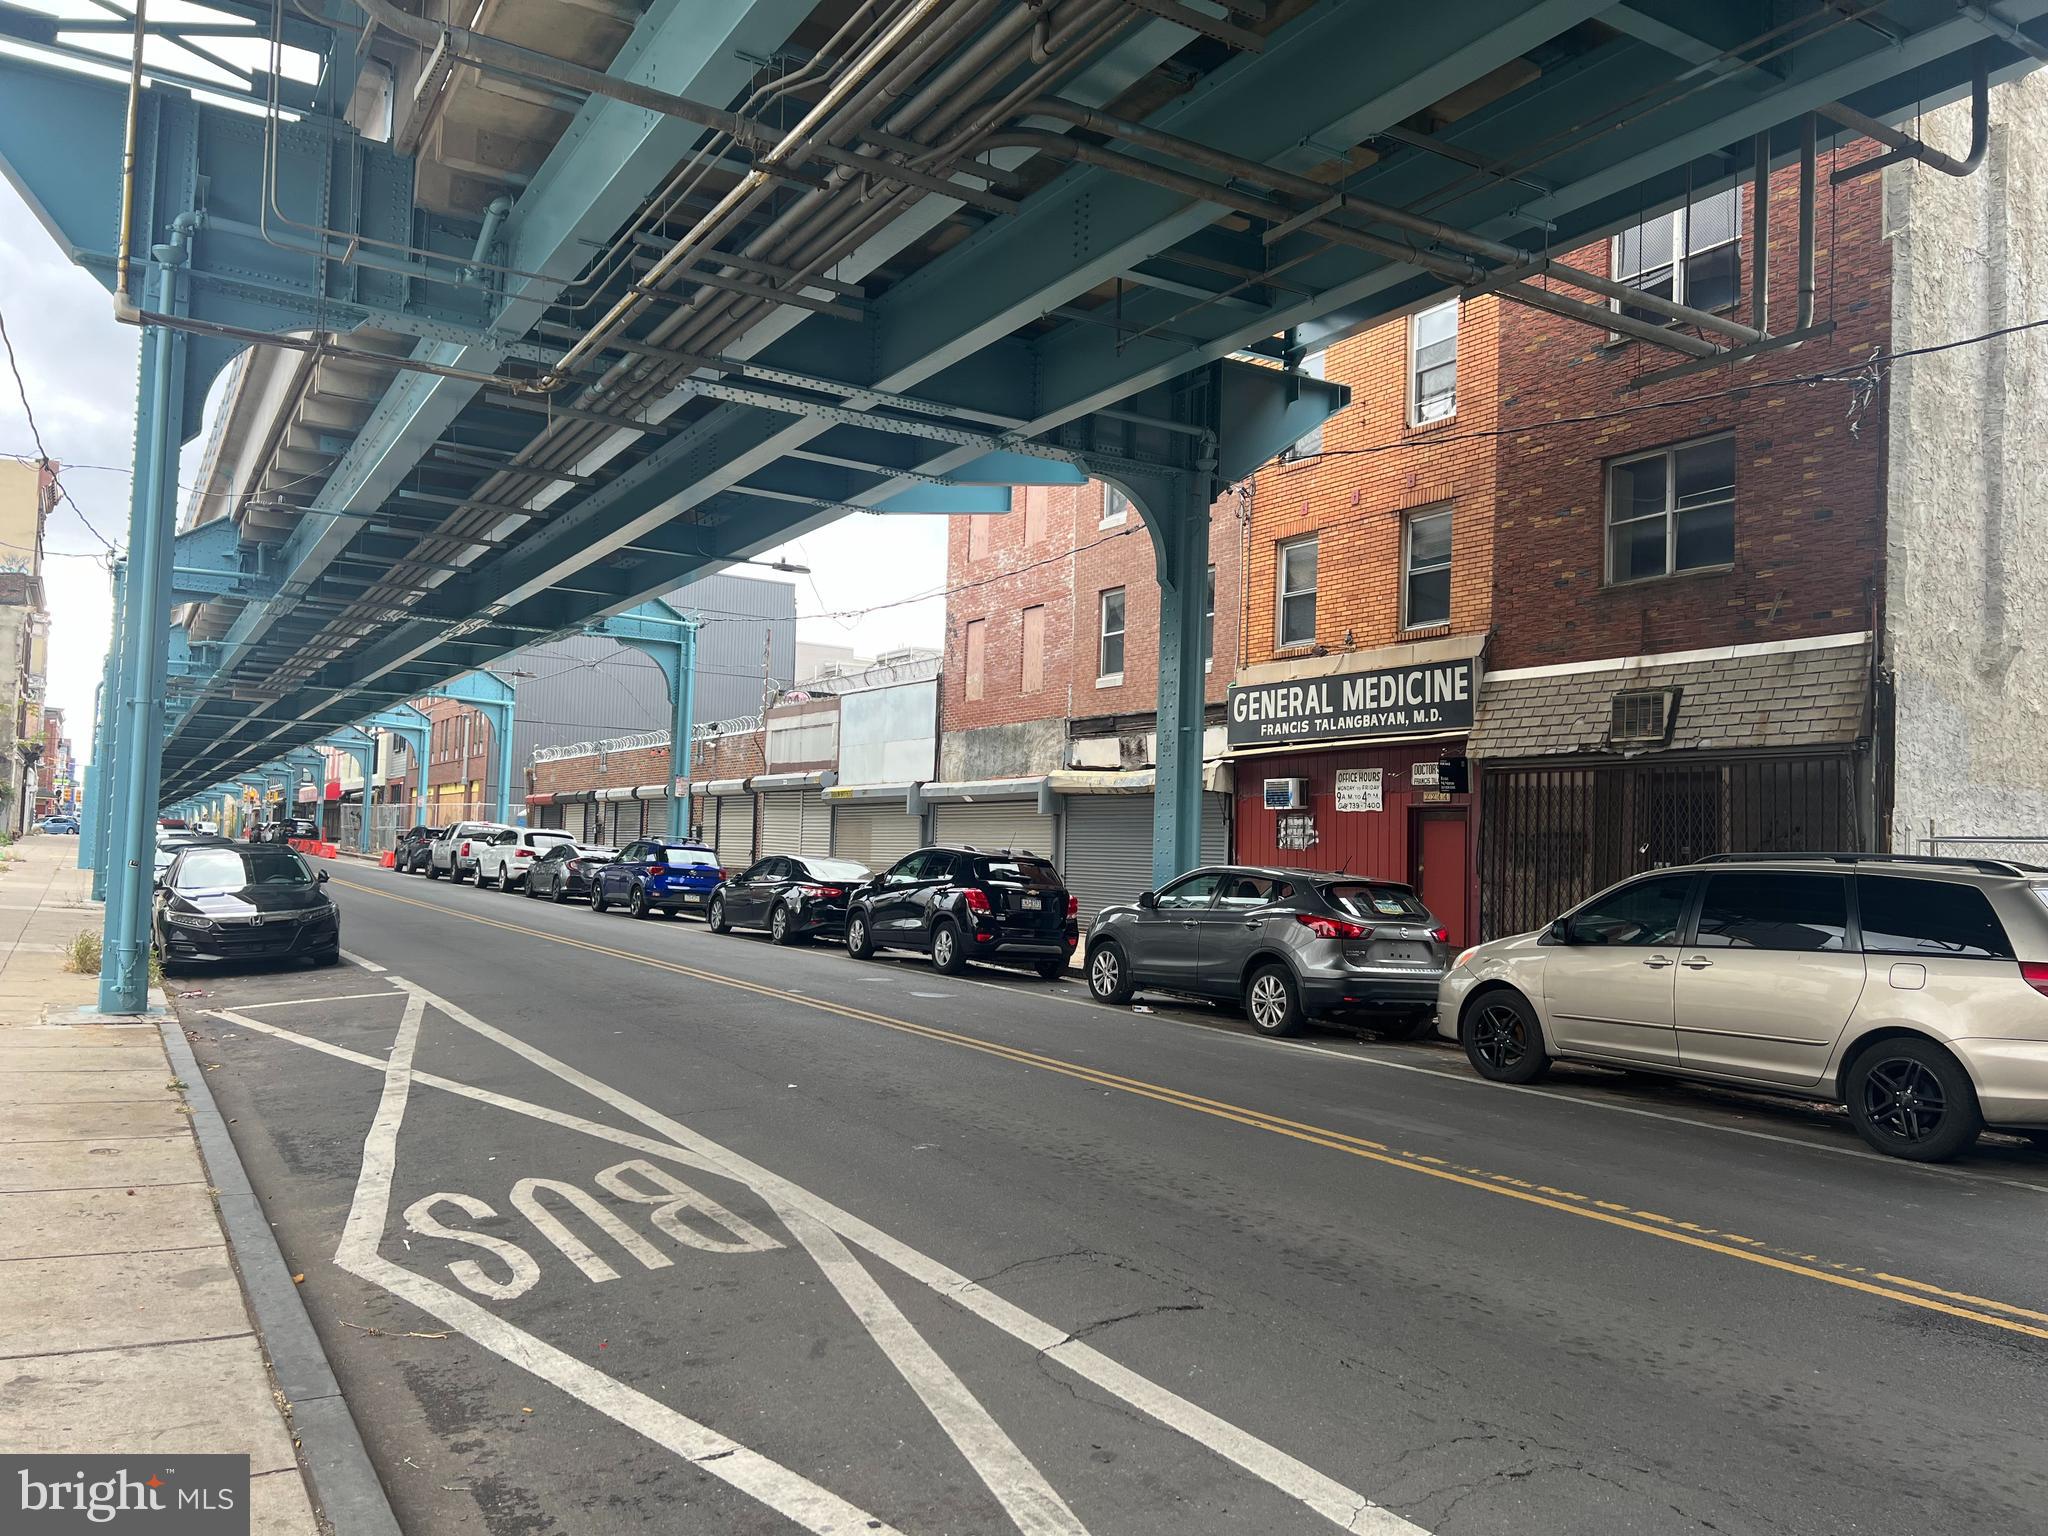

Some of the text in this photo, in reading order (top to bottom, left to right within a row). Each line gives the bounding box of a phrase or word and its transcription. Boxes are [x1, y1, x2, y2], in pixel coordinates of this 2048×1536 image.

[1233, 666, 1468, 723] GENERAL MEDICINE
[1260, 708, 1443, 736] FRANCIS TALANGBAYAN, M.D.
[1338, 771, 1381, 782] OFFICE HOURS
[403, 1159, 787, 1300] BUS
